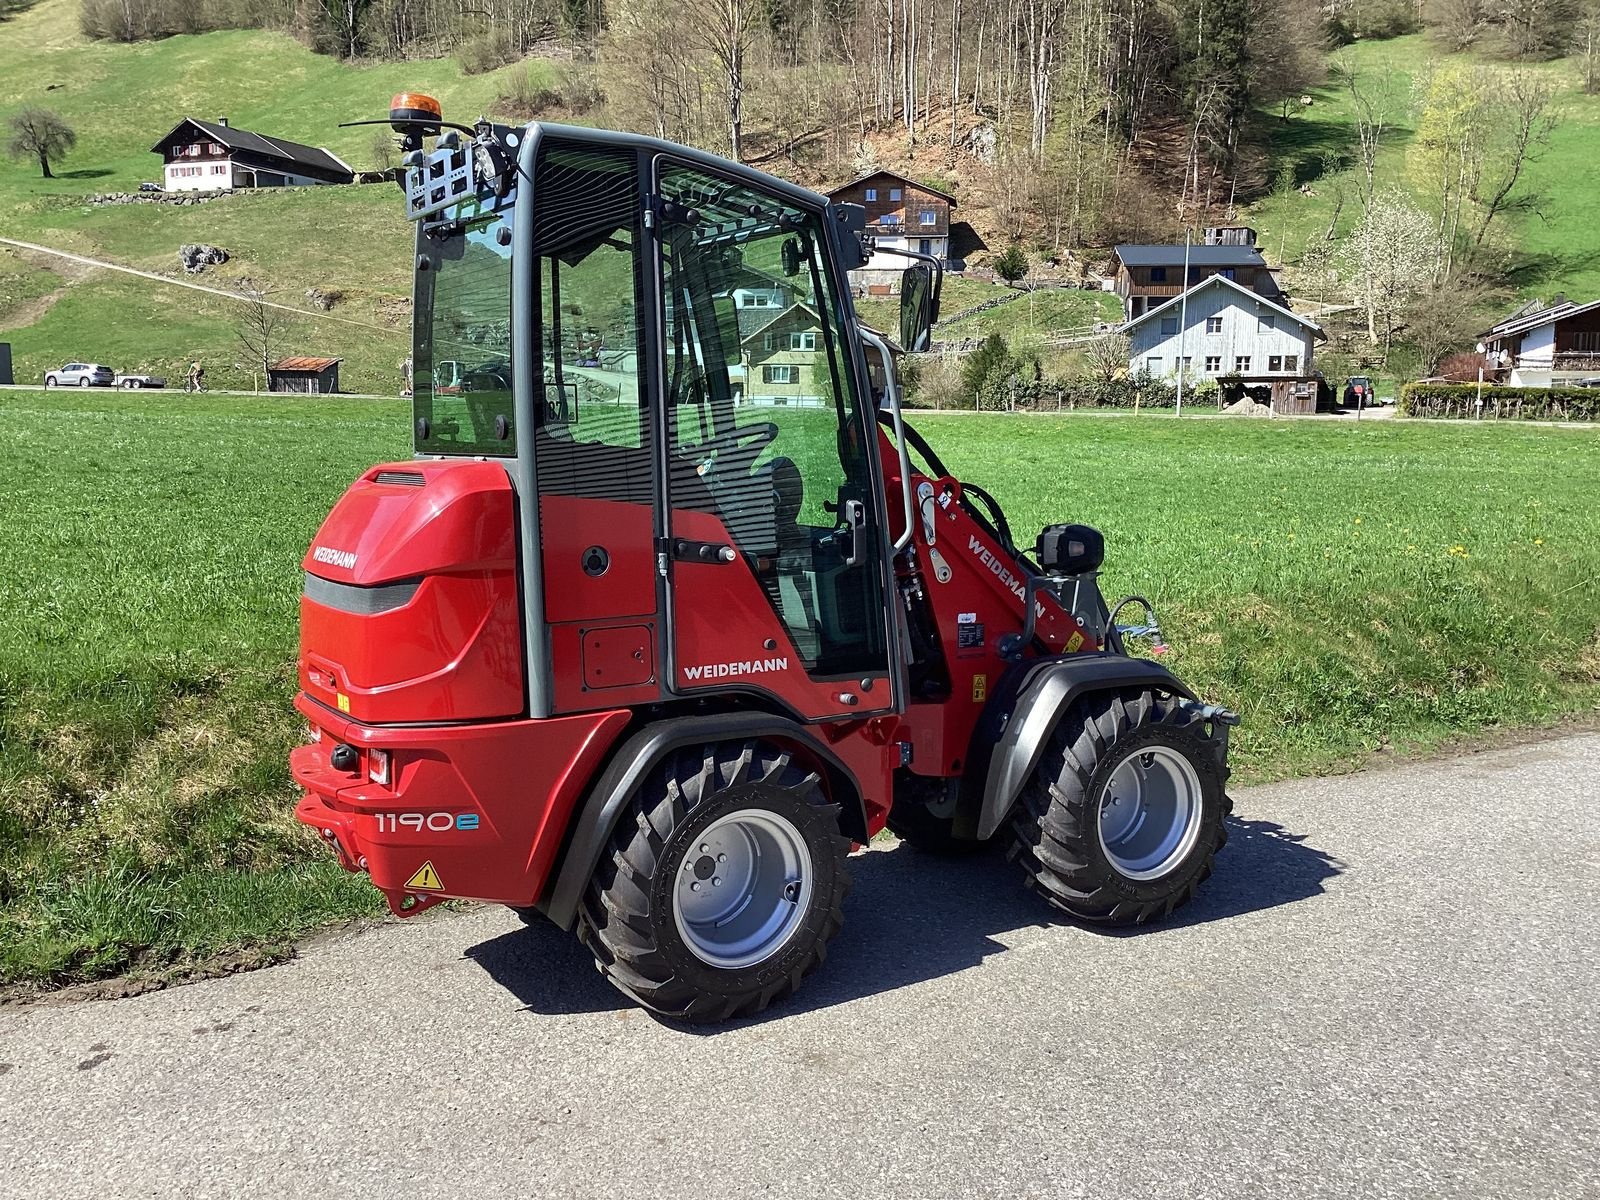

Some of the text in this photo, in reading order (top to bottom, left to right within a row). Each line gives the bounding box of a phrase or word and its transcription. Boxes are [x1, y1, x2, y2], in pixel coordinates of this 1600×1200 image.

[549, 401, 562, 420] 87
[313, 546, 358, 569] WEIDEMANN
[968, 534, 1046, 618] WEIDEMAN
[684, 658, 788, 680] WEIDEMANN
